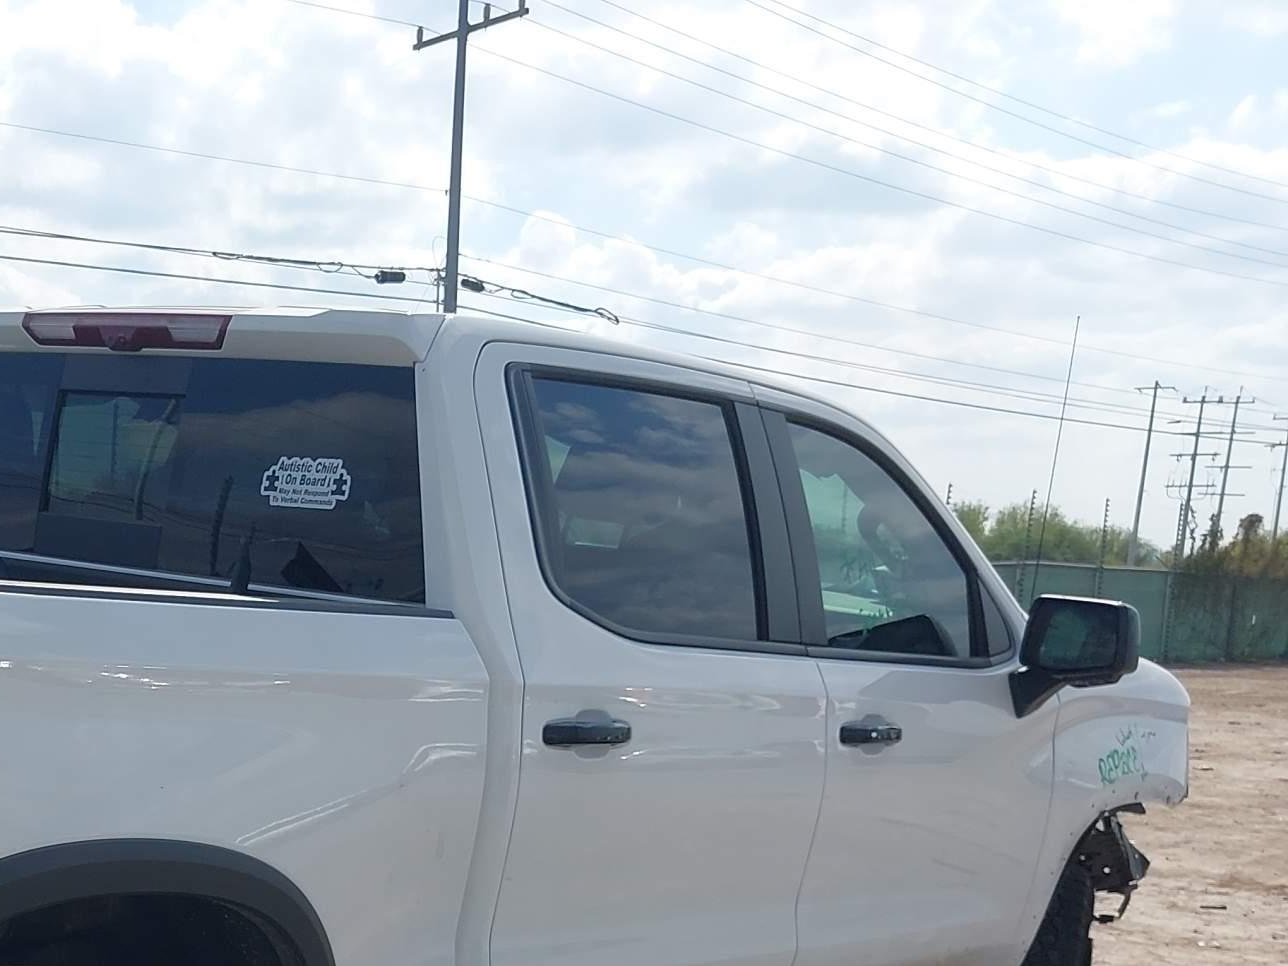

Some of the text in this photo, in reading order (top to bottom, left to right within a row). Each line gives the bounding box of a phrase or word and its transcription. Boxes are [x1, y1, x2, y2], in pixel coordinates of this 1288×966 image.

[278, 460, 339, 475] Autistic Child
[279, 487, 290, 497] May
[292, 488, 303, 496] Not
